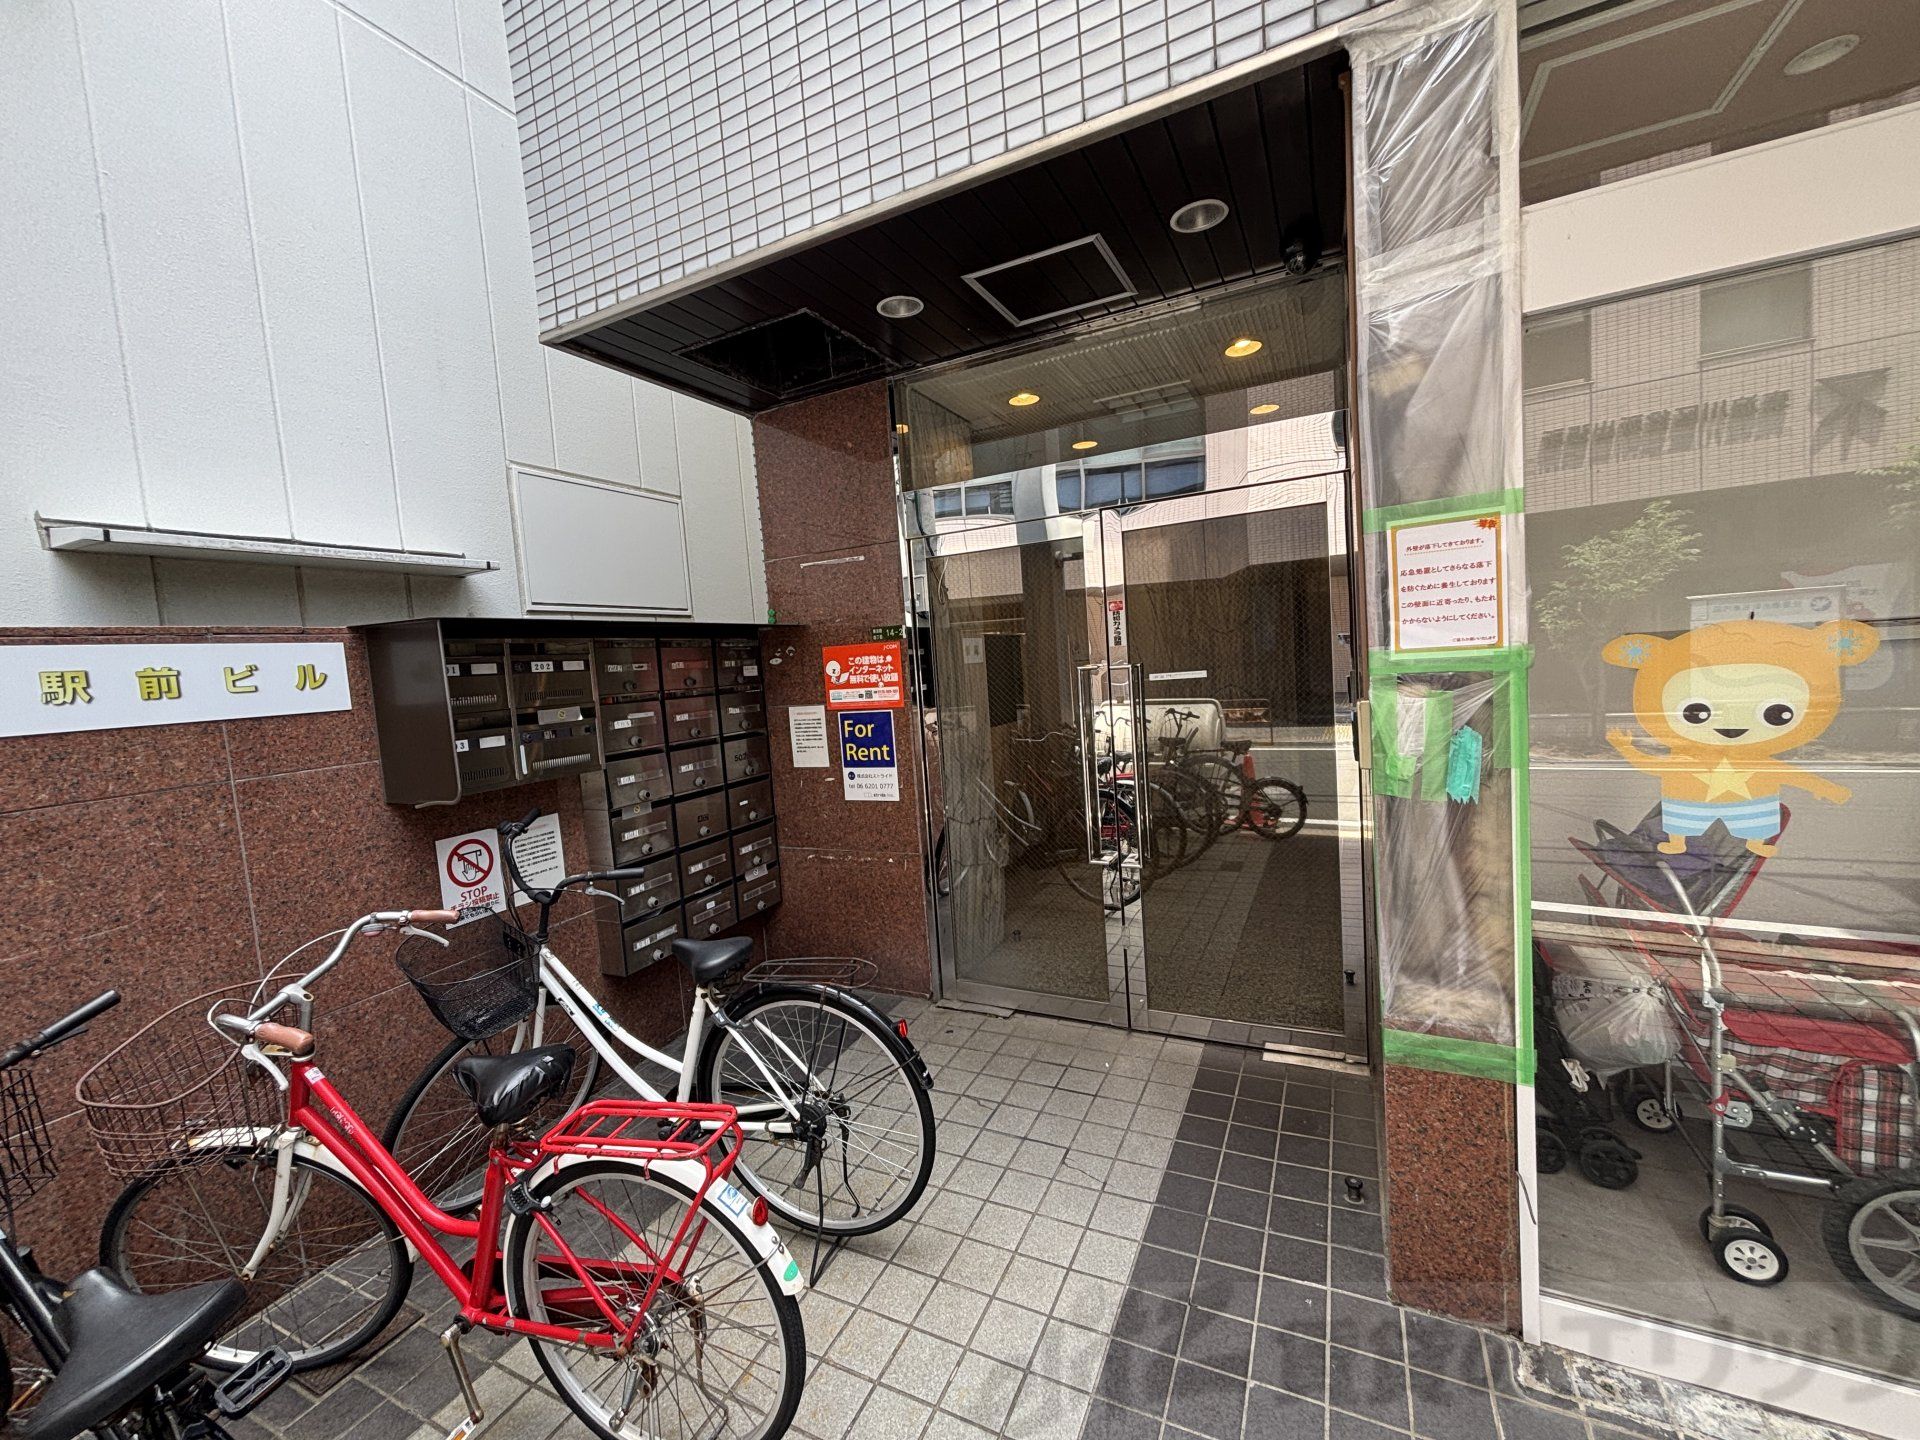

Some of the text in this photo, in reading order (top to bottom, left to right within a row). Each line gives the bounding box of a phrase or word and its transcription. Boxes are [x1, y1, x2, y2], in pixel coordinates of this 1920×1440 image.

[1406, 538, 1485, 553] 外壁が落下してきております。
[1400, 560, 1493, 577] 応急処置としてさらなる落下
[1400, 577, 1496, 593] を防ぐために養生しております
[1401, 594, 1496, 609] この壁面に近寄ったり、もたれ
[1402, 611, 1495, 625] かからないようにしてください。
[848, 655, 885, 666] この建物は
[849, 664, 894, 674] インターネット
[38, 663, 329, 705] 駅前ビル
[849, 672, 899, 684] 無料で使い放題
[844, 720, 875, 738] For
[846, 743, 890, 761] Rent
[460, 886, 488, 903] STOP
